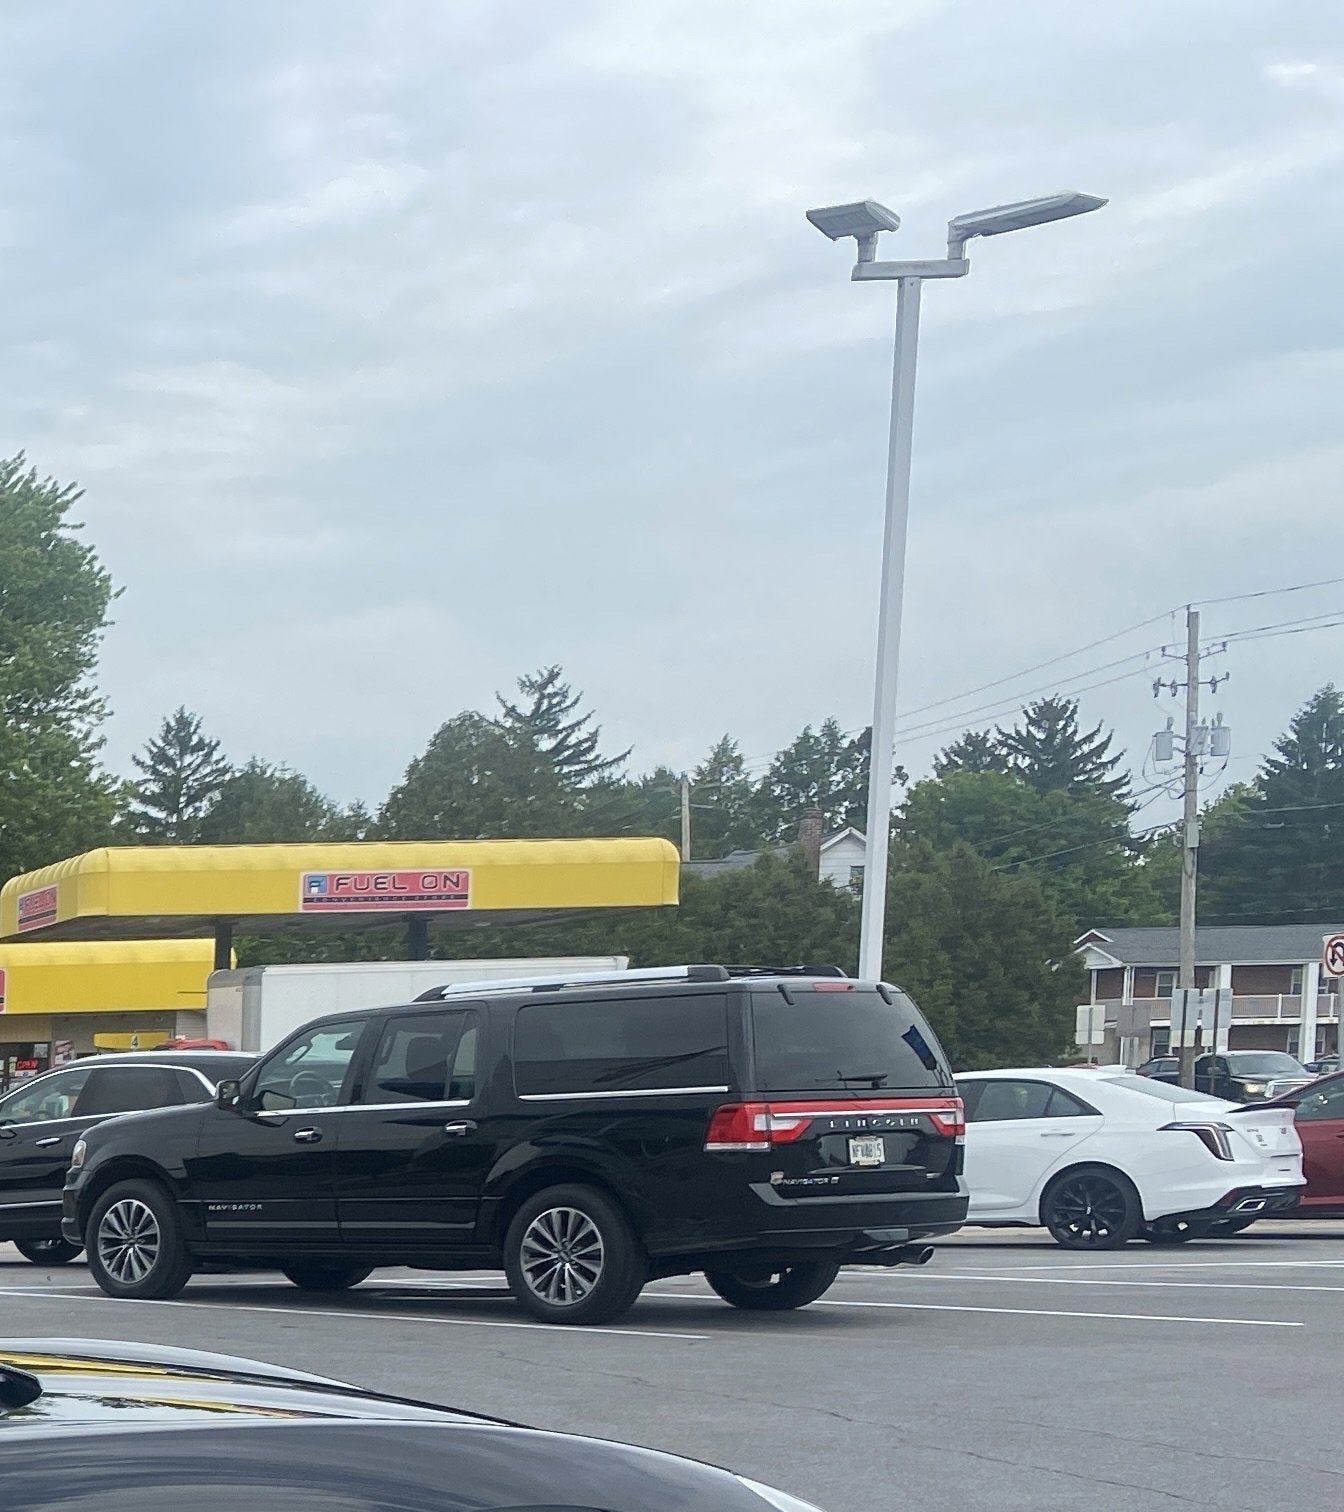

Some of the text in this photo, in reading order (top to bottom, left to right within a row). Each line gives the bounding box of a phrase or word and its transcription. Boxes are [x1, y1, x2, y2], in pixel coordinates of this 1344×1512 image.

[335, 874, 461, 891] FUEL ON
[131, 1035, 139, 1048] 4
[16, 1059, 38, 1069] OPEN
[830, 1118, 919, 1128] LINCOLN
